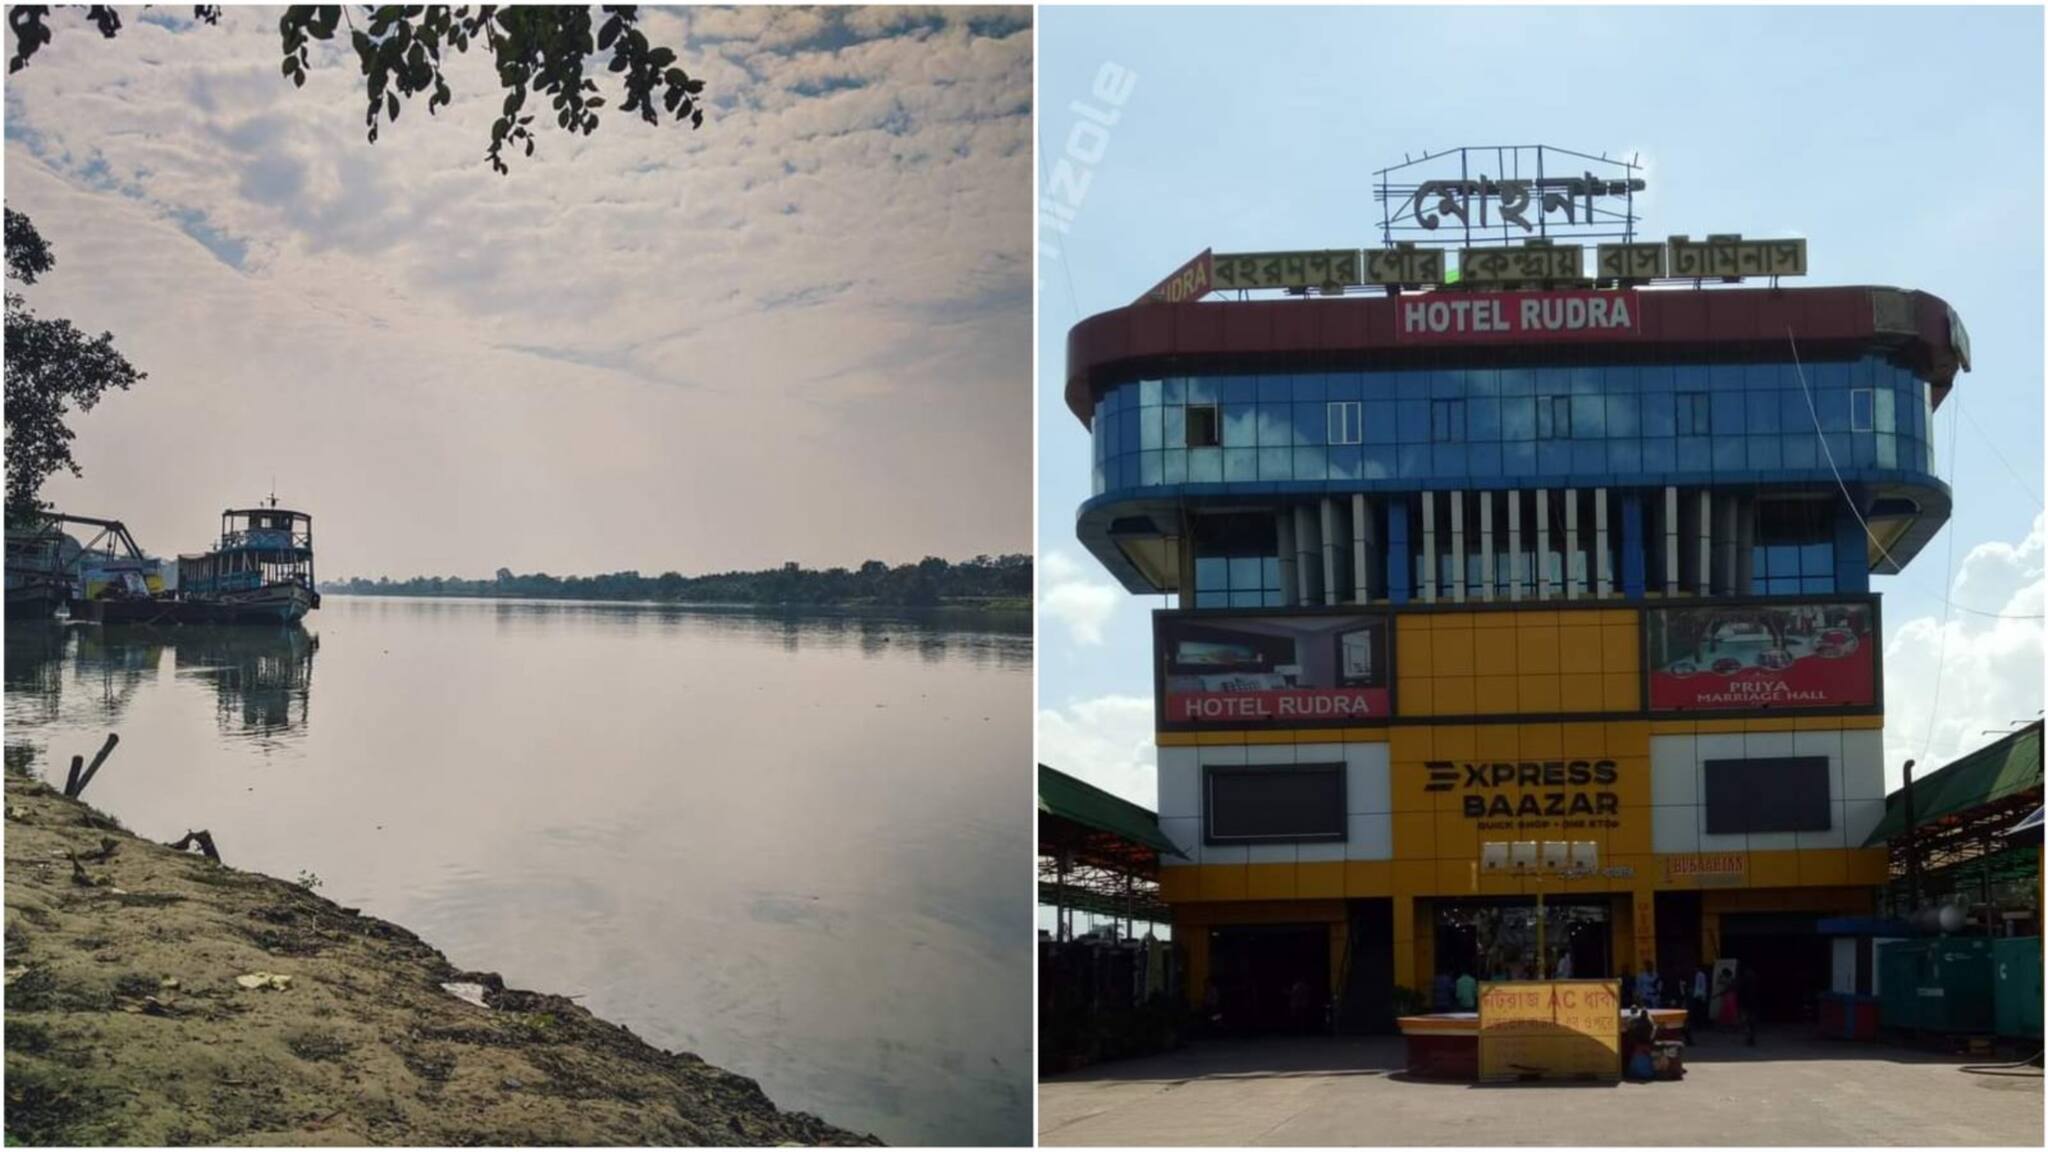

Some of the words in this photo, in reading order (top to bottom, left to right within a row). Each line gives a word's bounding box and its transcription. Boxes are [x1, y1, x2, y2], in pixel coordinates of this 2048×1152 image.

[1414, 171, 1606, 232] মোহনা
[1216, 250, 1356, 294] বহরমপুর
[1366, 244, 1439, 284] পৌর
[1603, 246, 1660, 276] বাস
[1405, 301, 1511, 333] HOTEL
[1520, 297, 1631, 330] RUDRA
[1697, 692, 1781, 702] MARRIAGE
[1787, 690, 1827, 701] HALL
[1729, 680, 1789, 693] PRIYA
[1185, 697, 1271, 717] HOTEL
[1278, 695, 1369, 715] RUDRA
[1424, 760, 1619, 792] EXPRESS
[1463, 792, 1619, 818] BAAZAR
[1478, 821, 1513, 830] QUICK
[1518, 820, 1549, 829] SHOP
[1548, 989, 1577, 1009] AC
